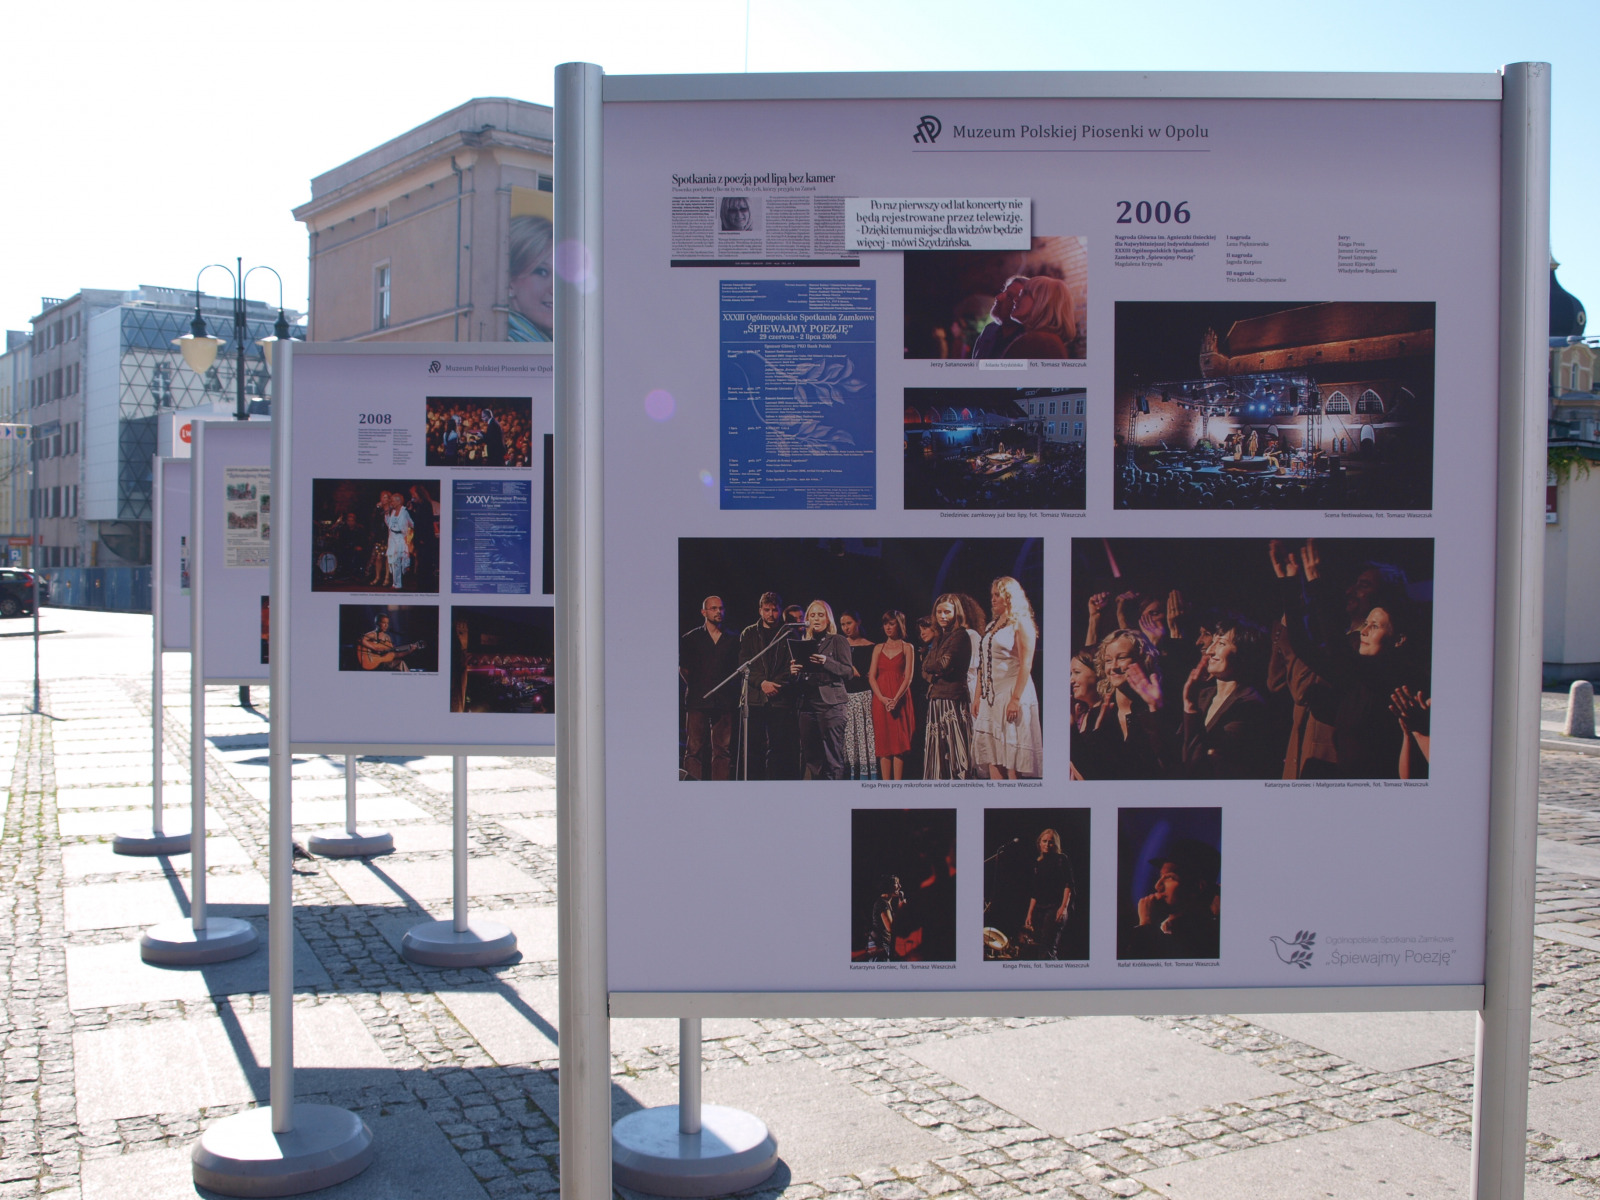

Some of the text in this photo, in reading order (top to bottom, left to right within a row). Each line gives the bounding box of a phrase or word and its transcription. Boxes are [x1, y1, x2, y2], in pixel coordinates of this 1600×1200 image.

[953, 124, 1209, 141] Muzeum Polskiej Piosenki w Opolu
[672, 173, 835, 187] Spotkania z poezją pod lipą bez kamer
[871, 200, 883, 209] Po
[899, 200, 940, 212] pierwszy
[940, 200, 953, 209] od
[953, 200, 965, 209] lat
[966, 200, 1007, 211] koncerty
[1008, 200, 1023, 209] nie
[856, 212, 1023, 224] będą rejestrowane przez telewizję.
[1116, 201, 1191, 224] 2006
[861, 225, 889, 237] Dzięki
[890, 226, 913, 235] temu
[914, 225, 942, 237] miejsc
[943, 224, 957, 235] dla
[957, 224, 993, 235] widzów
[993, 225, 1023, 236] będzie
[856, 238, 885, 249] więcej
[892, 237, 917, 247] mówi
[918, 237, 972, 249] Szydzińska.
[746, 313, 798, 323] Ogólnopolskie
[800, 313, 837, 323] Spotkania
[838, 313, 875, 321] Zamkowe
[475, 365, 500, 373] Polskiej
[537, 365, 553, 373] Opol
[359, 413, 392, 425] 2008
[466, 495, 490, 504] XXXV
[1326, 934, 1454, 946] Ogólnopolskie Spotkania Zamkowe
